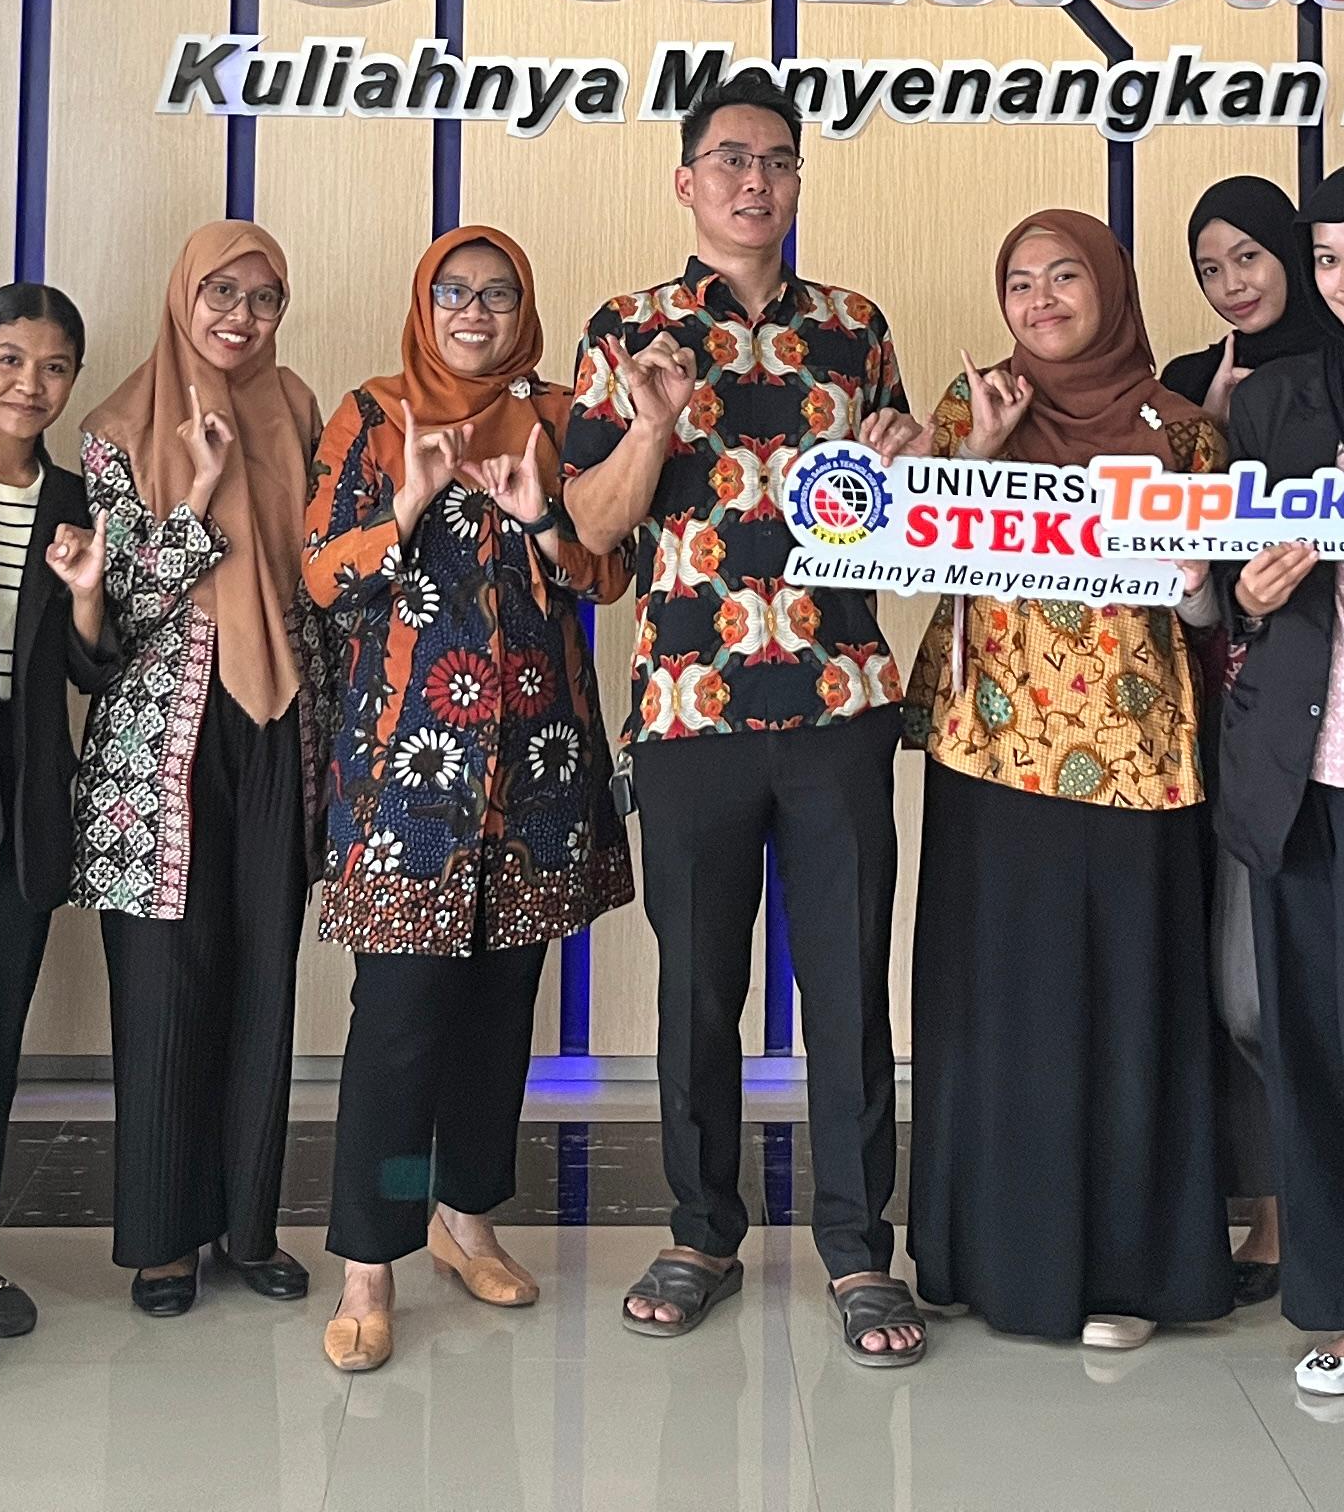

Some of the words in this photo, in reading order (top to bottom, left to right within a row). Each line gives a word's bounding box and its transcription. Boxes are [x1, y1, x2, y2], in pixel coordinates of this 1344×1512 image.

[166, 40, 622, 129] Kuliahnya
[906, 465, 1098, 504] UNIVERSI
[1107, 536, 1286, 552] E-BKK+Trace
[792, 556, 936, 589] Kuliahnya
[944, 564, 1160, 599] Menyenangkan
[1167, 577, 1178, 597] !
